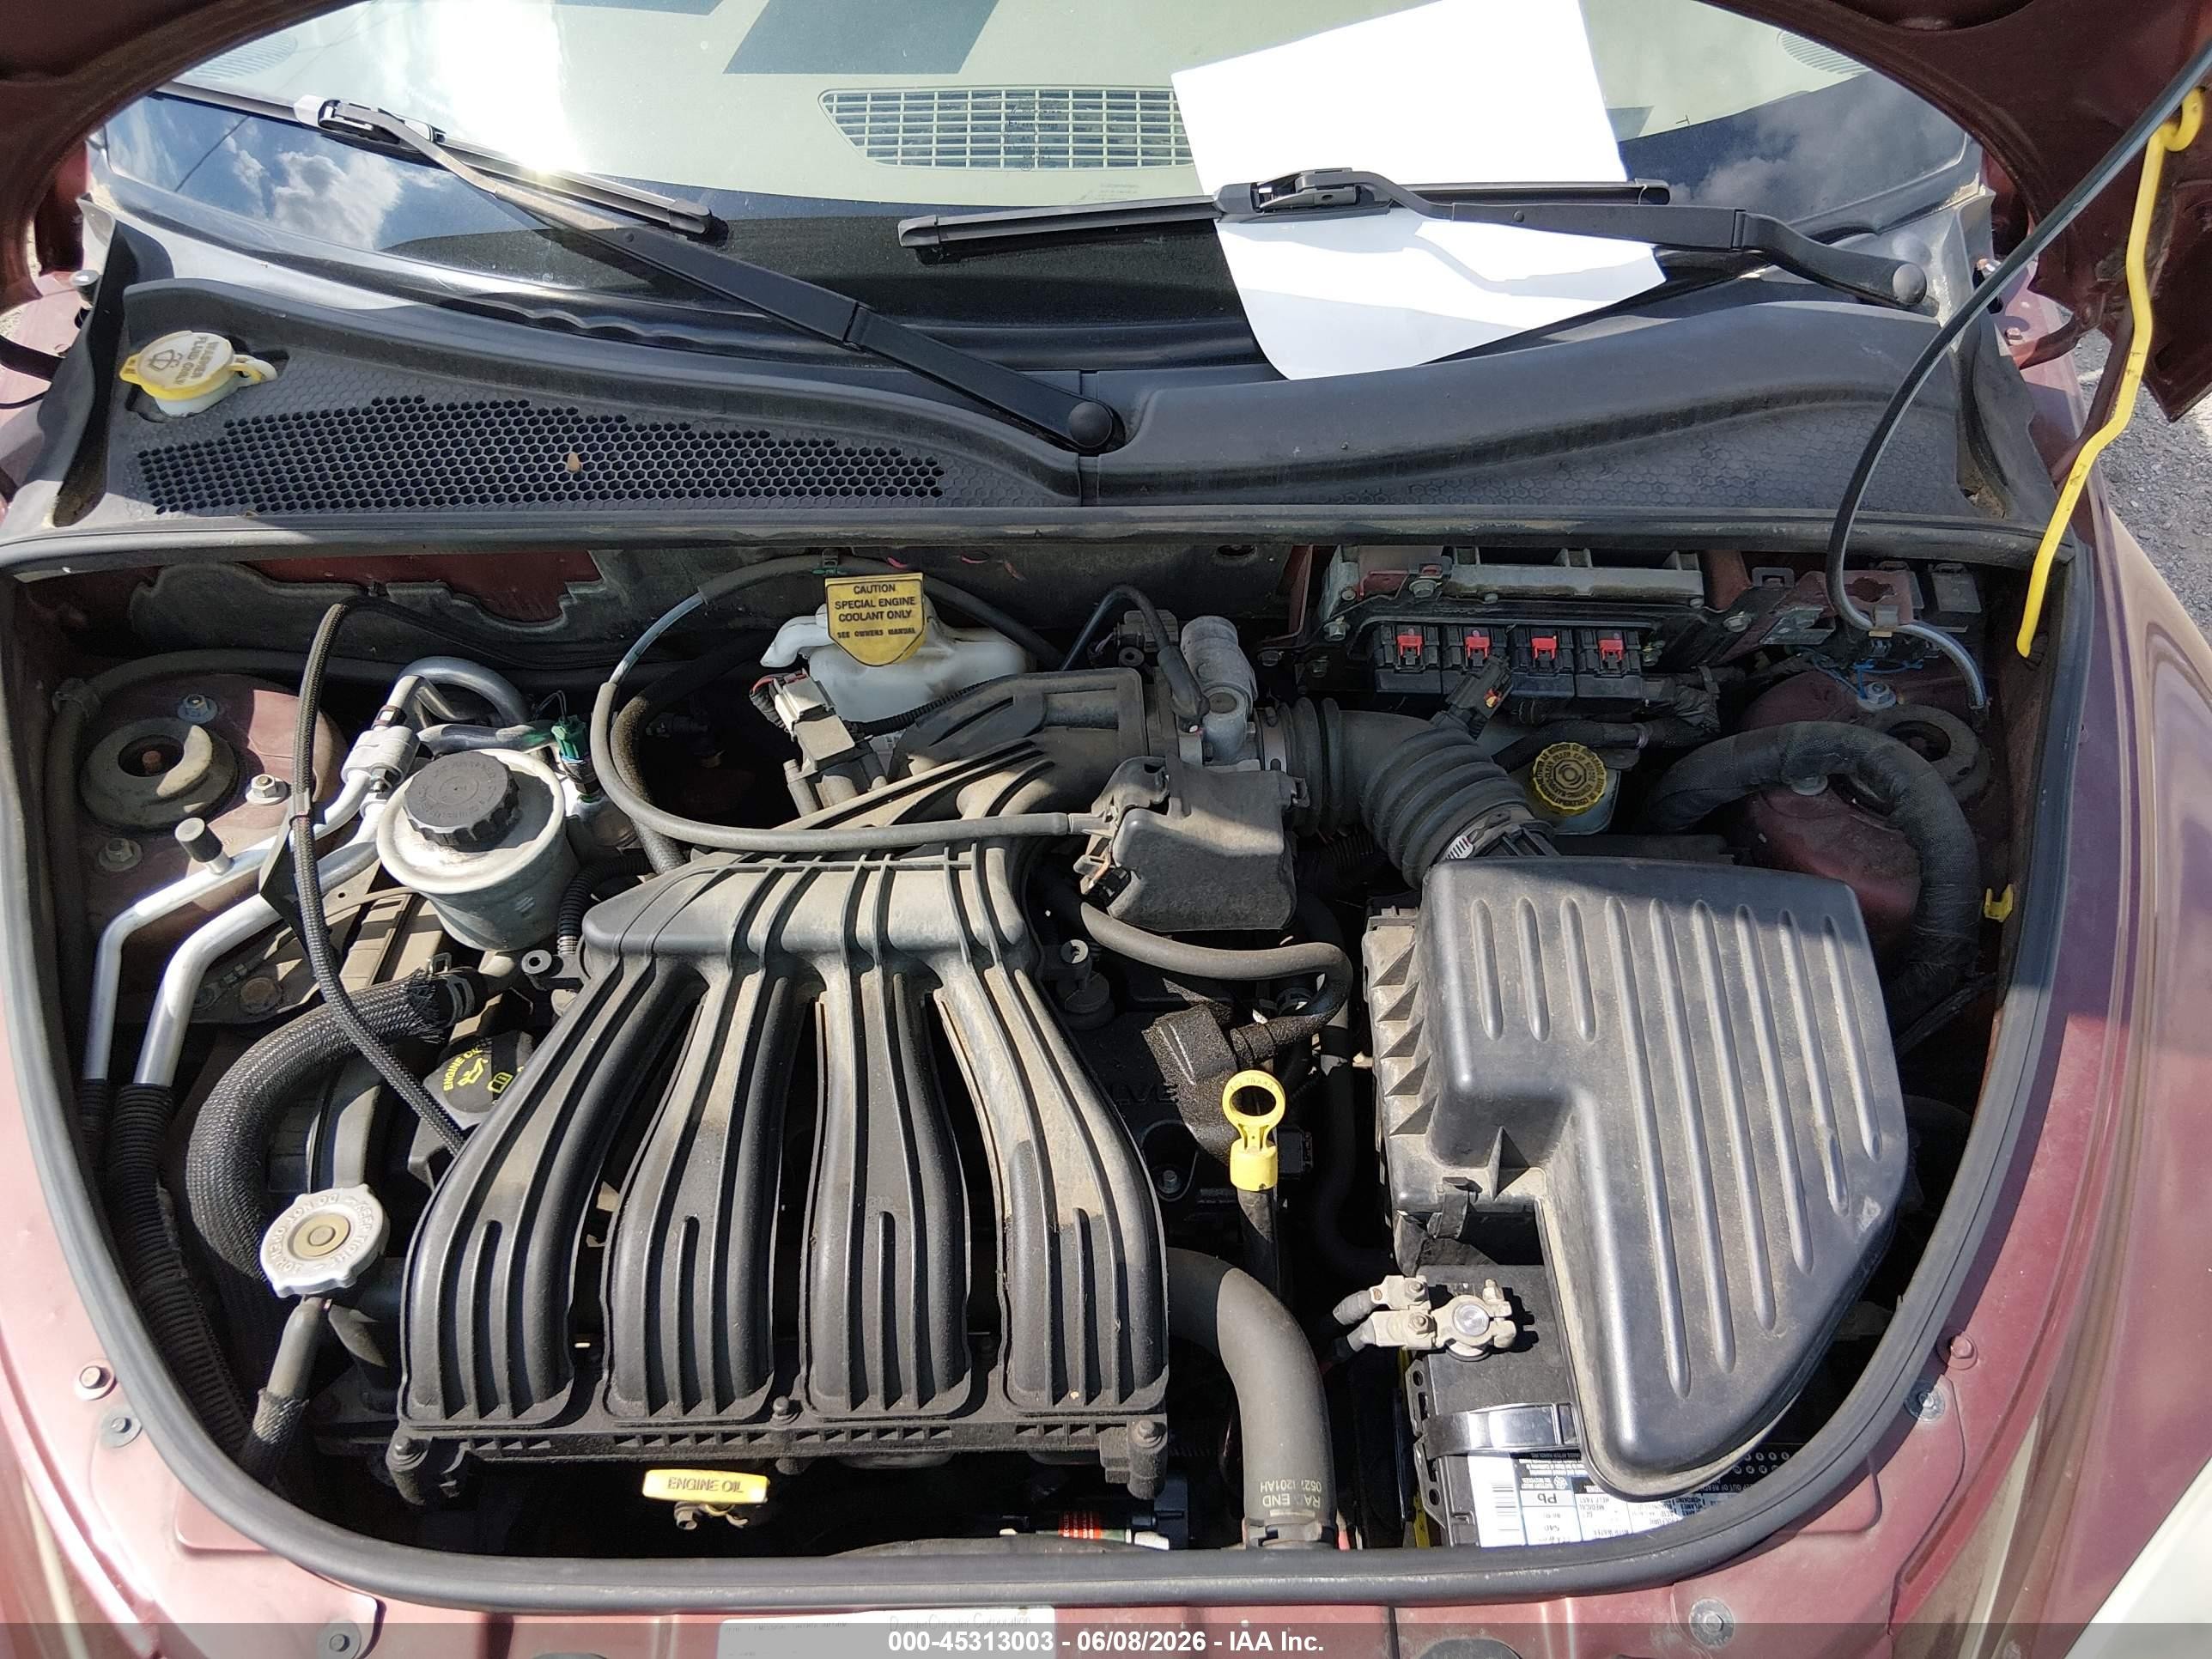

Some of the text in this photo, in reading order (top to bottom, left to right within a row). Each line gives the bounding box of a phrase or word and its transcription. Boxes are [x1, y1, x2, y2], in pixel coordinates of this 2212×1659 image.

[854, 584, 896, 595] CAUTION
[834, 596, 916, 611] SPECIAL ENGINE
[838, 609, 913, 623] COOLANT ONLY
[888, 626, 916, 635] MANUAL
[443, 1056, 466, 1091] ENGINE
[667, 1476, 744, 1493] ENGINE OIL
[1262, 1492, 1291, 1508] END
[1537, 1492, 1557, 1504] Pb
